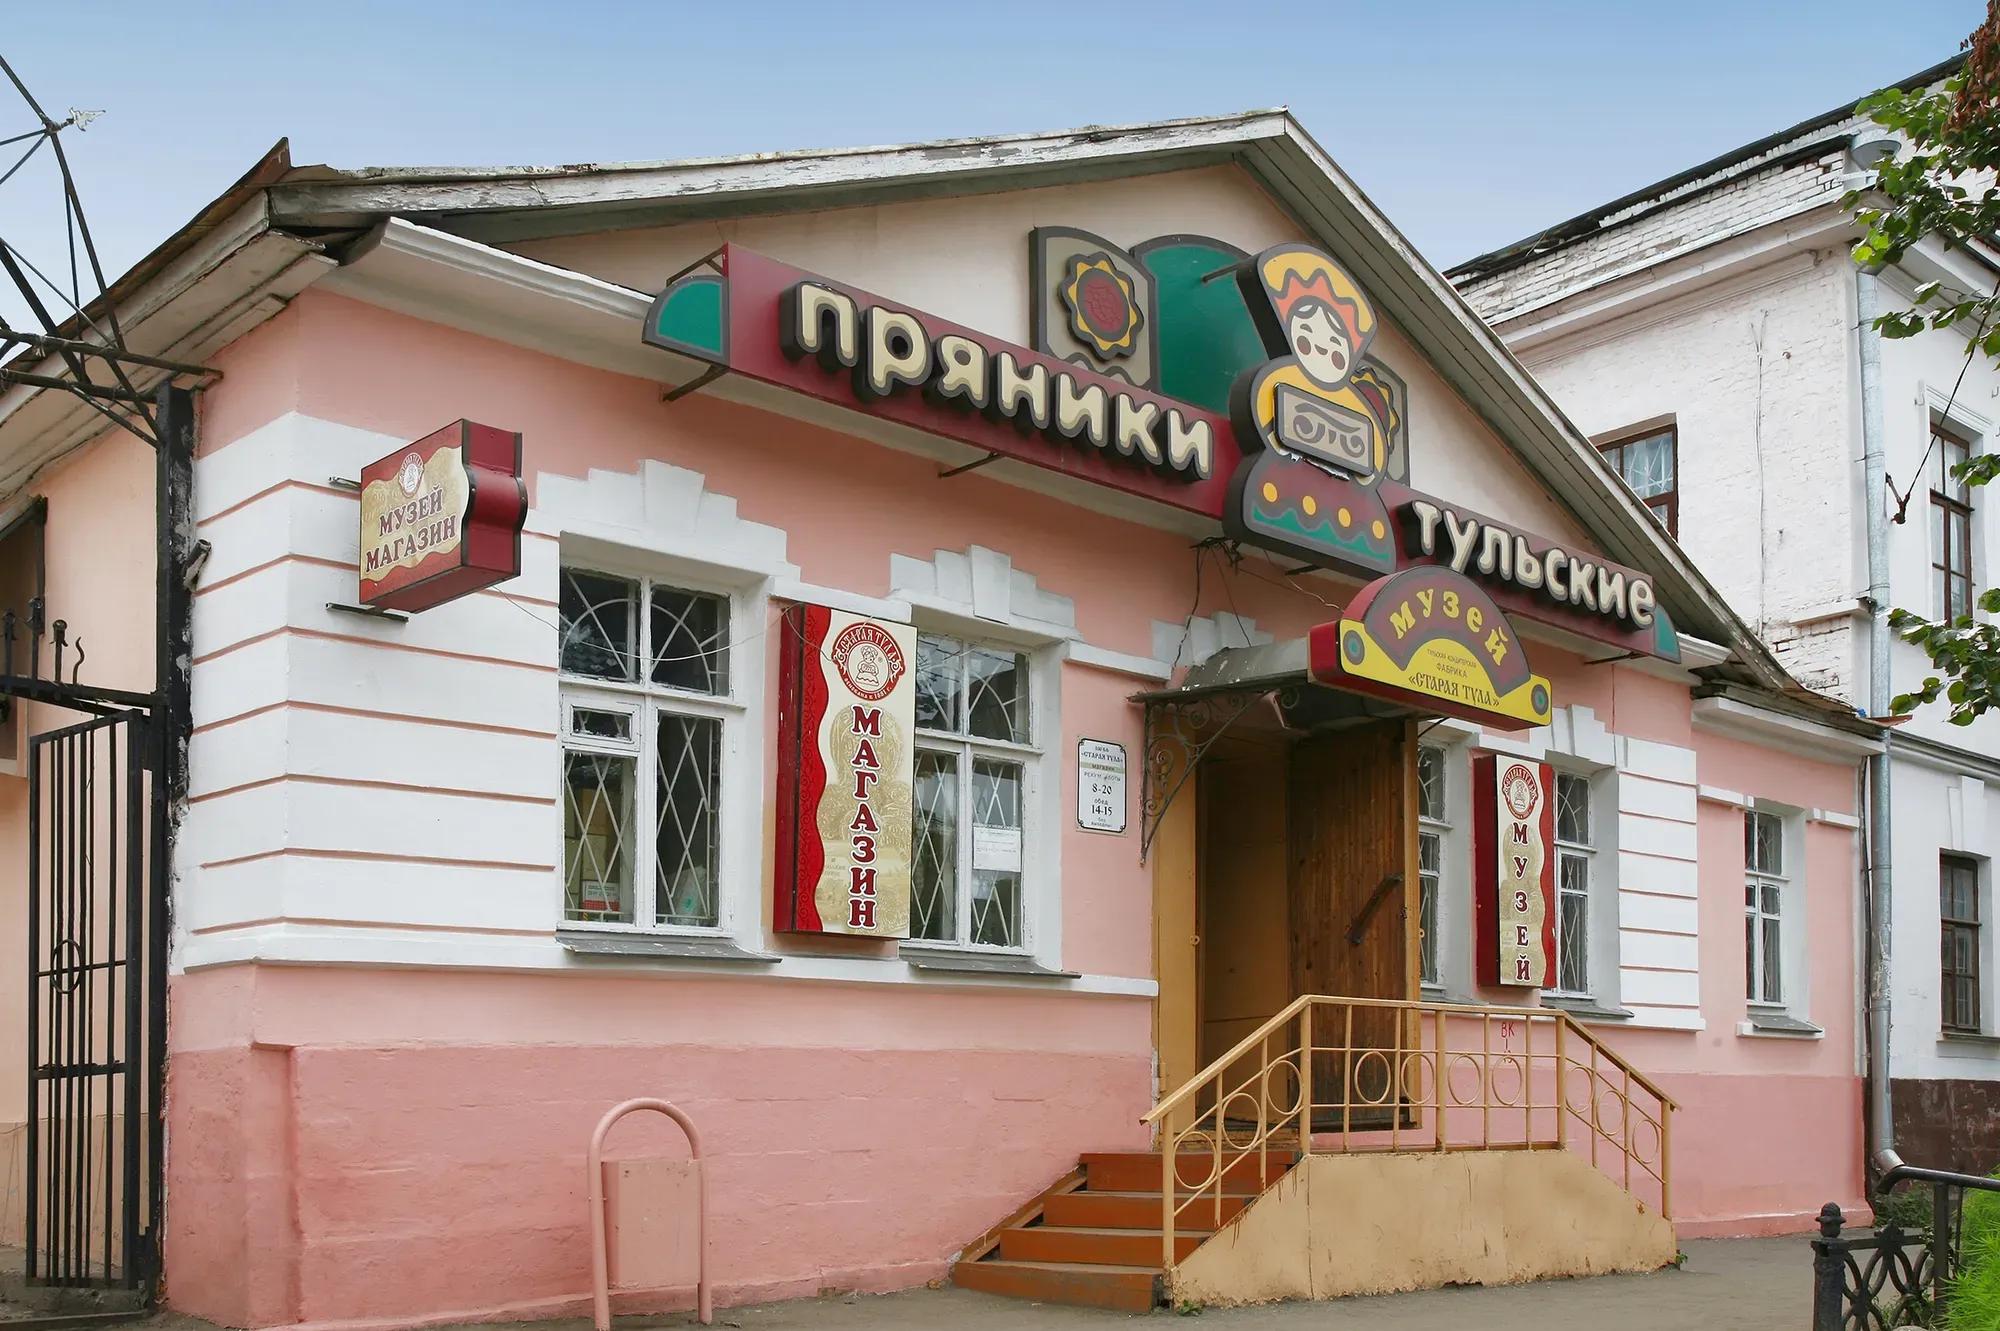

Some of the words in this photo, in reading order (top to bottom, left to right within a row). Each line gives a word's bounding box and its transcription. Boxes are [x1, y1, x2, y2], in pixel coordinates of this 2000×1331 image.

[378, 483, 443, 537] МУЗЕЙ
[366, 515, 456, 573] МАГАЗИН
[840, 629, 873, 652] СТАРАЯ
[875, 631, 897, 660] ТУЛА
[1408, 672, 1458, 697] «СТАРАЯ
[1462, 685, 1500, 706] ТУЛА»
[1436, 663, 1468, 678] ФАБРИКА
[849, 705, 881, 928] МАГАЗИН
[1091, 804, 1113, 816] 14-15
[1512, 822, 1531, 981] МУЗЕЙ
